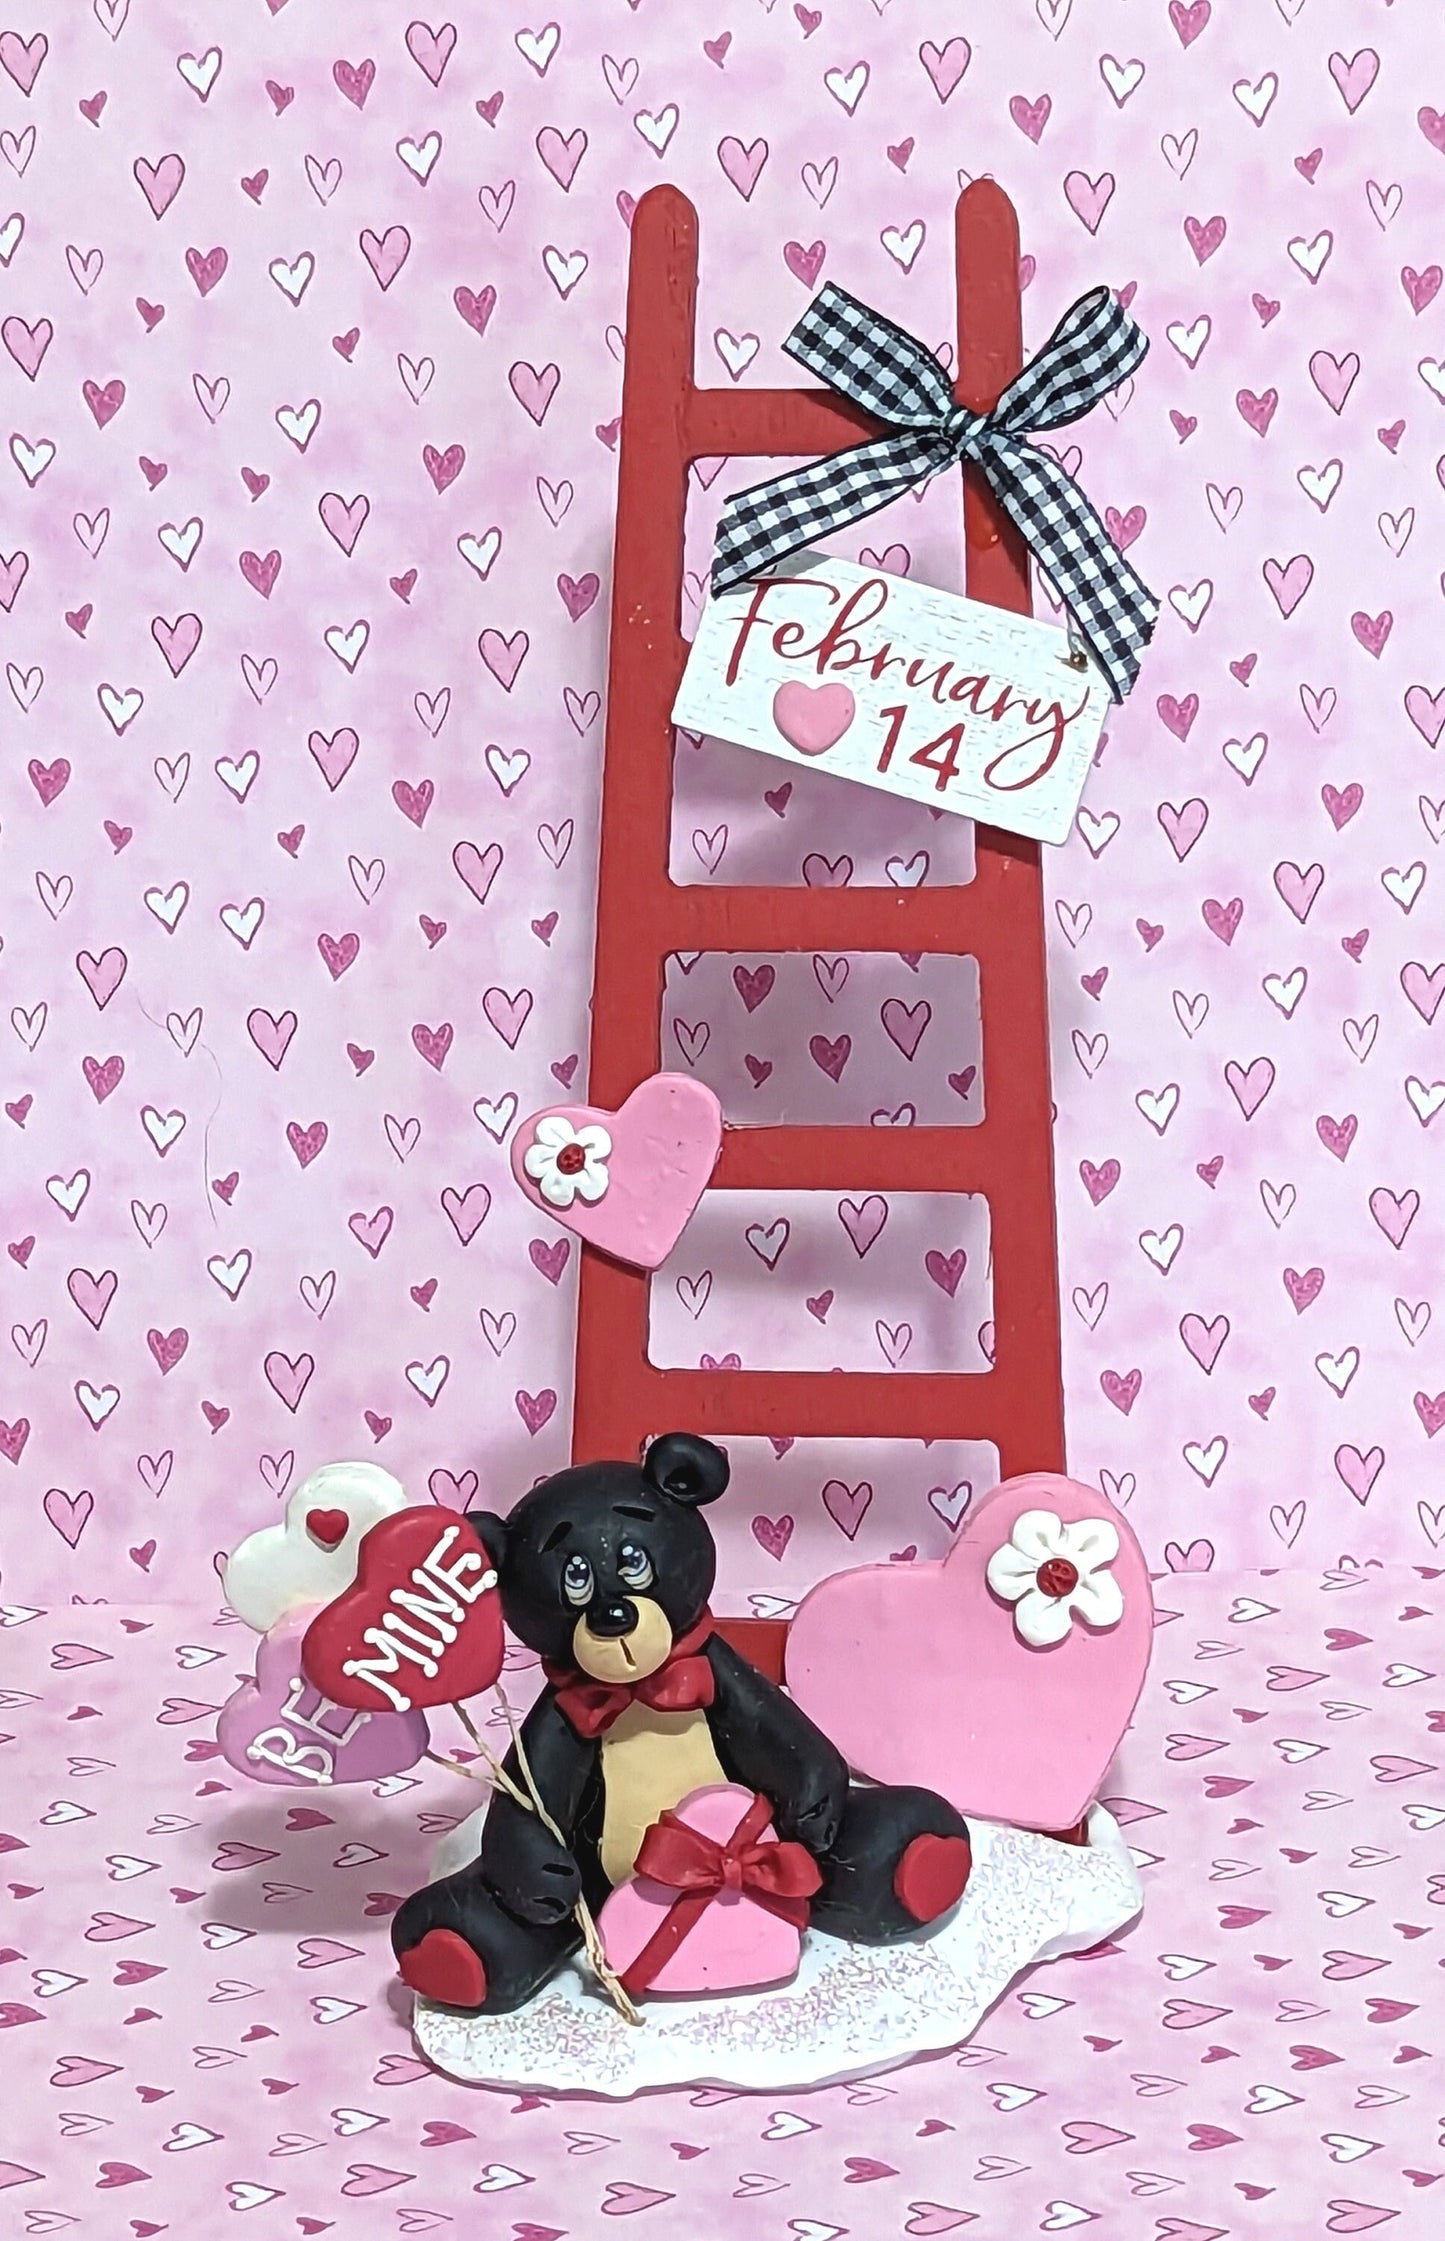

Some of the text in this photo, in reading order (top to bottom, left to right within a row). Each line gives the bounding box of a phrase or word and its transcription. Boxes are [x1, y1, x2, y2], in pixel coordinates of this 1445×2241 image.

[725, 576, 1091, 791] February
[877, 703, 966, 792] 14
[342, 1525, 498, 1712] MINE
[246, 1676, 372, 1784] BE
